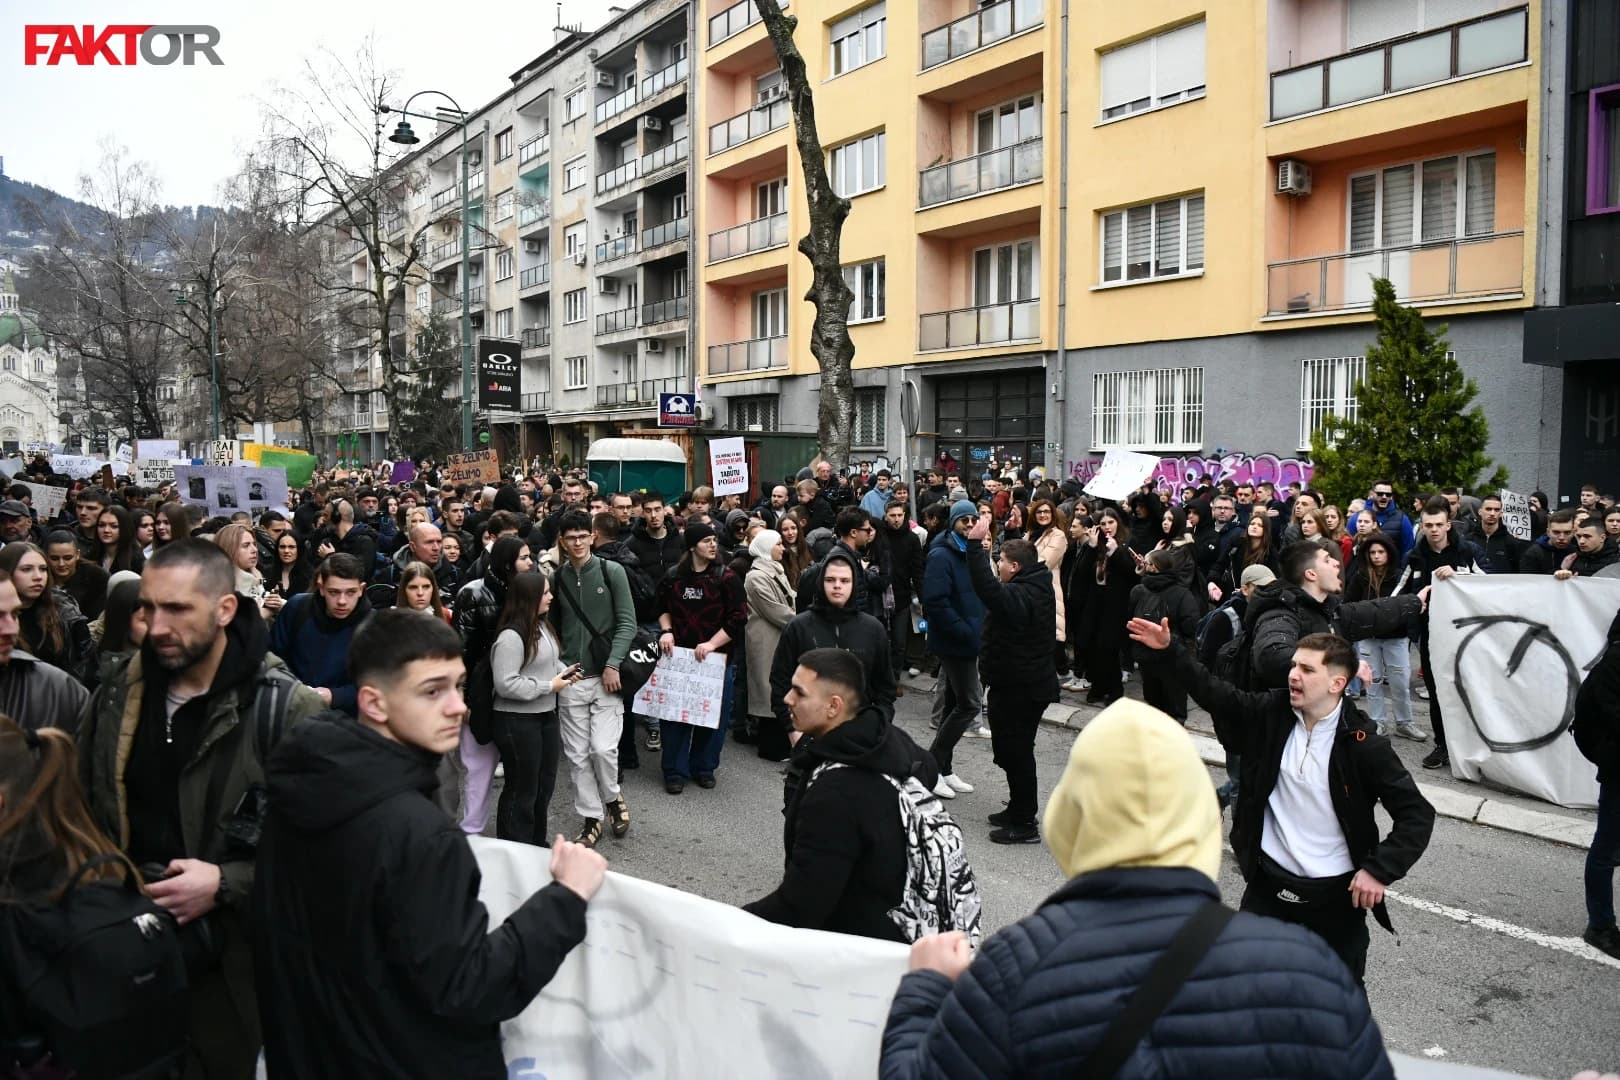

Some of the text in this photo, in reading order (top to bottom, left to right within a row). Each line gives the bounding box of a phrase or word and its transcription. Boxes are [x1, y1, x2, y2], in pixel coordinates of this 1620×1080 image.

[482, 362, 518, 371] OAKLEY
[448, 454, 460, 465] NE
[1280, 889, 1300, 901] NIKE
